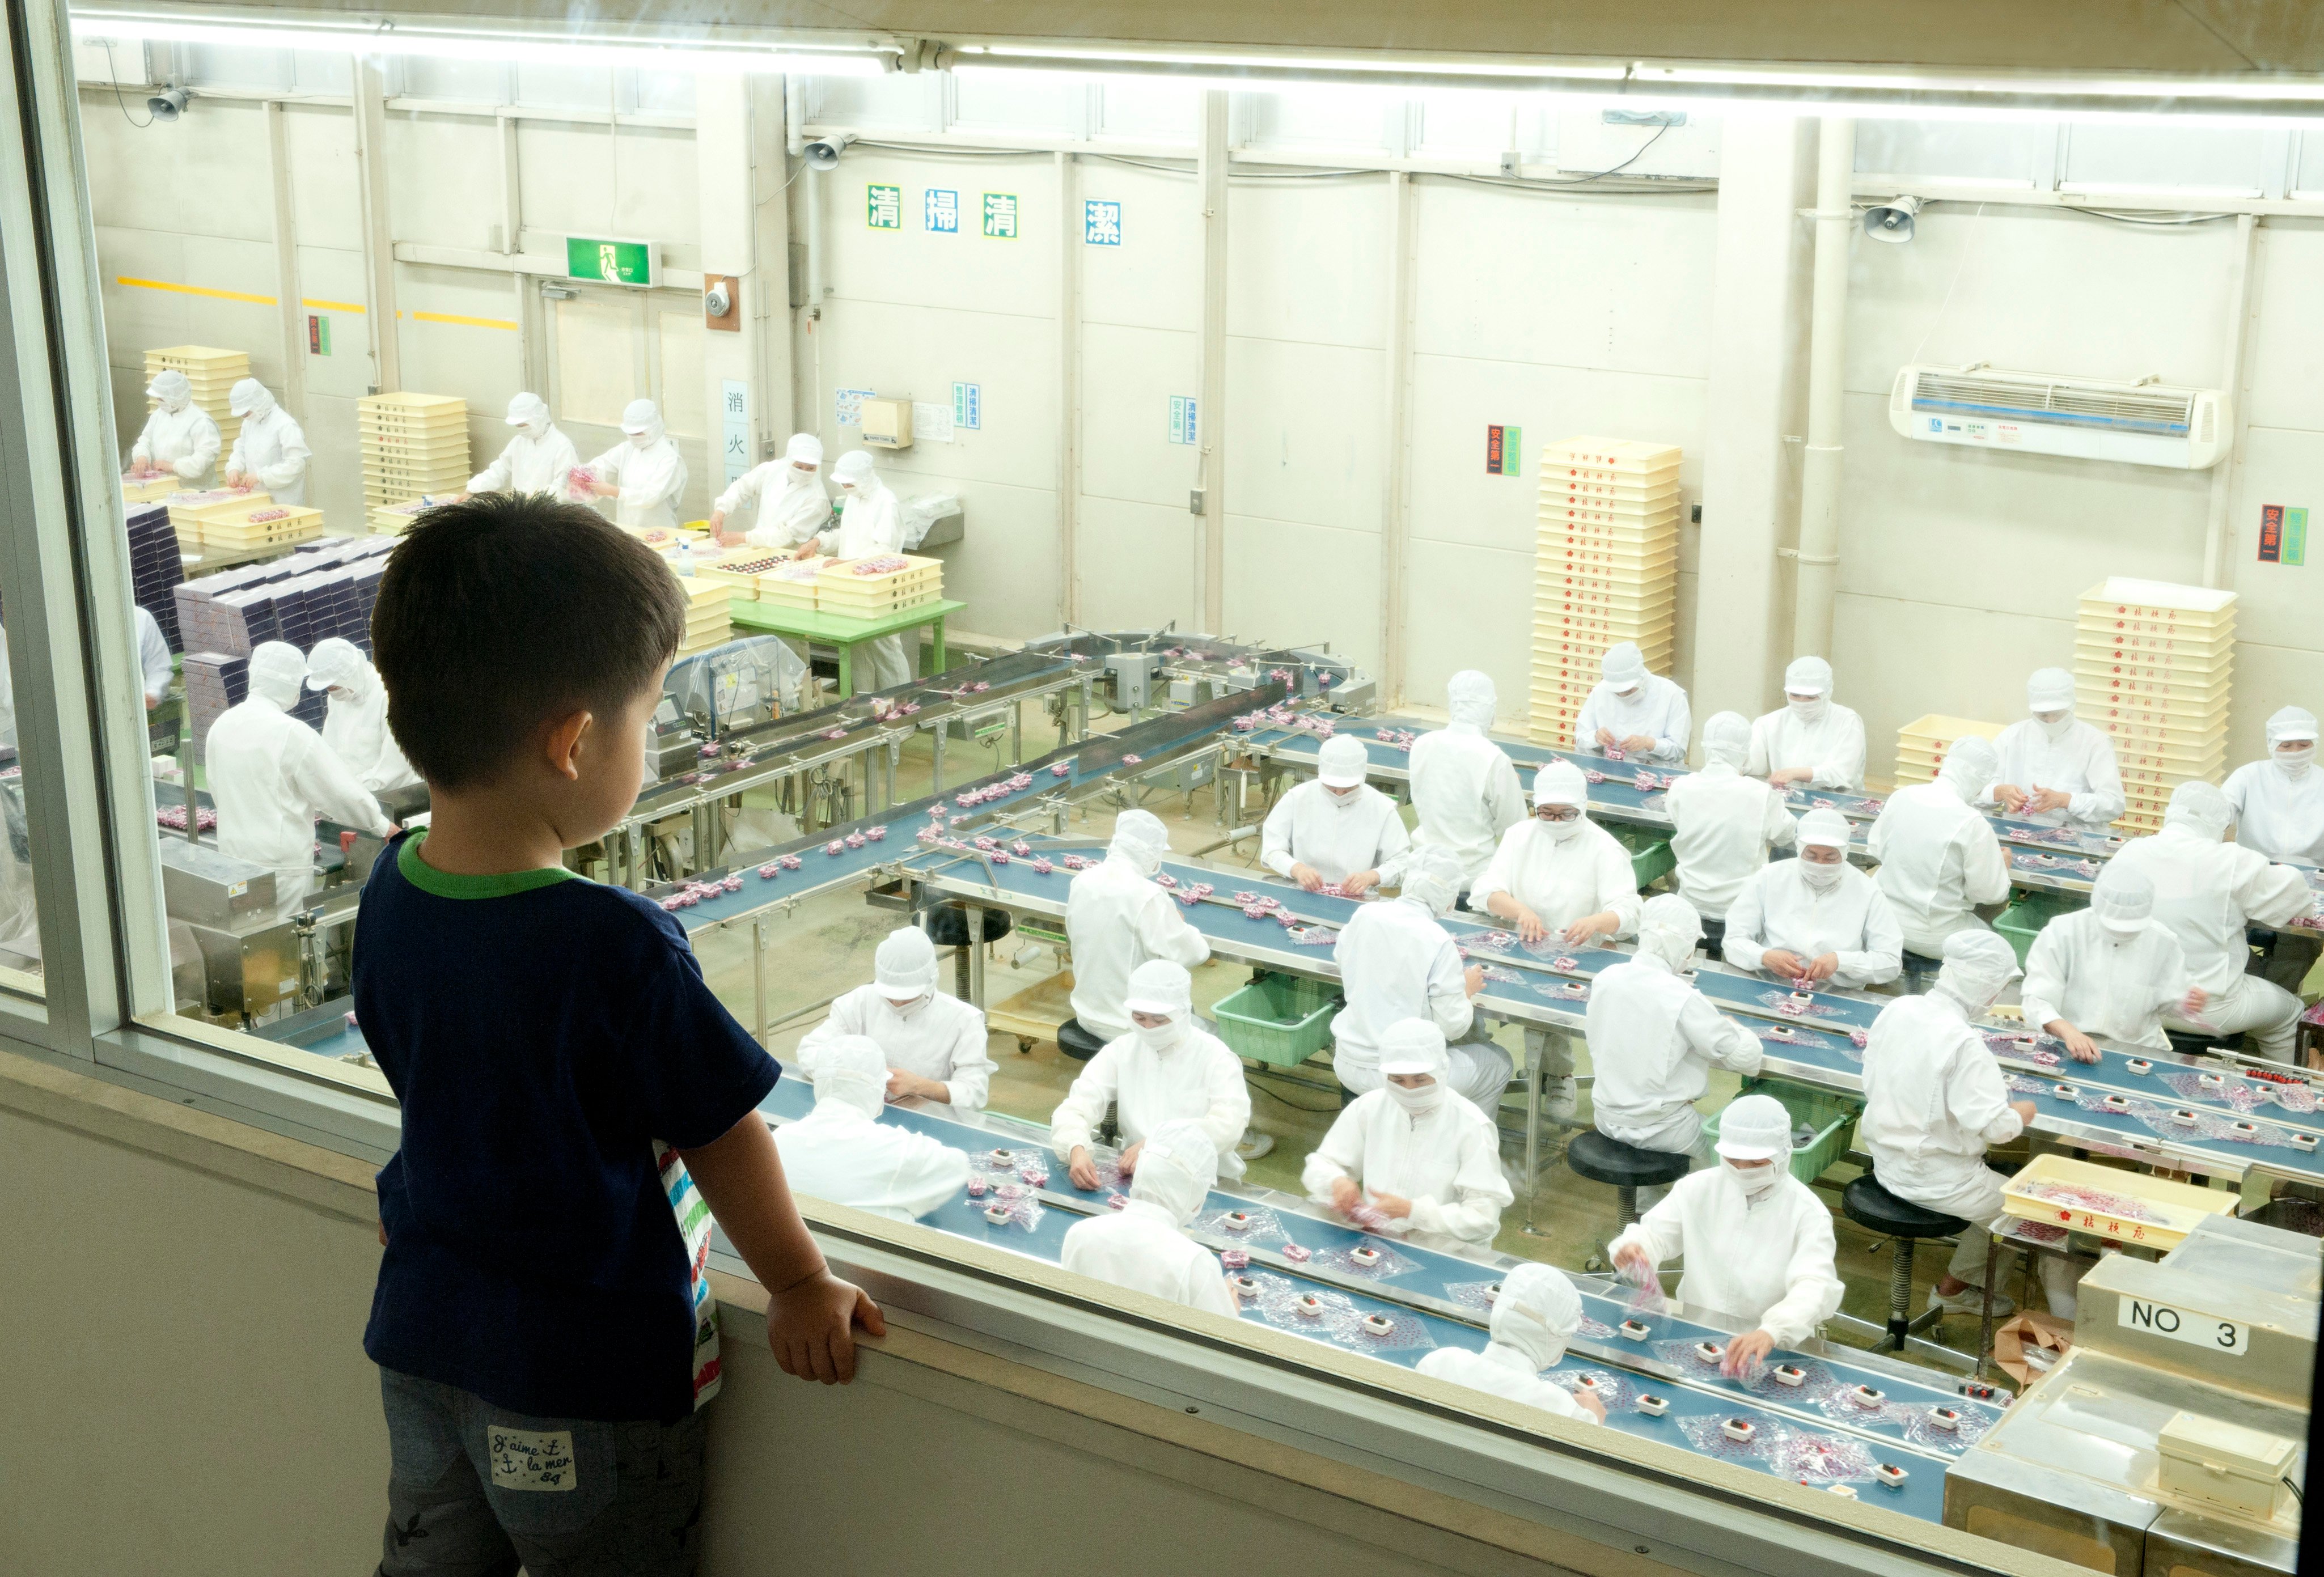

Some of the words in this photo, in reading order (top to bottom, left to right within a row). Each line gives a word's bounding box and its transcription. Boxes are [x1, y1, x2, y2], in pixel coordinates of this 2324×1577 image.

[1172, 400, 1181, 436] 安全第一
[2262, 509, 2279, 553] 安全第一
[2132, 1302, 2180, 1333] NO
[2217, 1323, 2236, 1347] 3
[527, 1456, 542, 1471] la
[545, 1456, 572, 1469] mer
